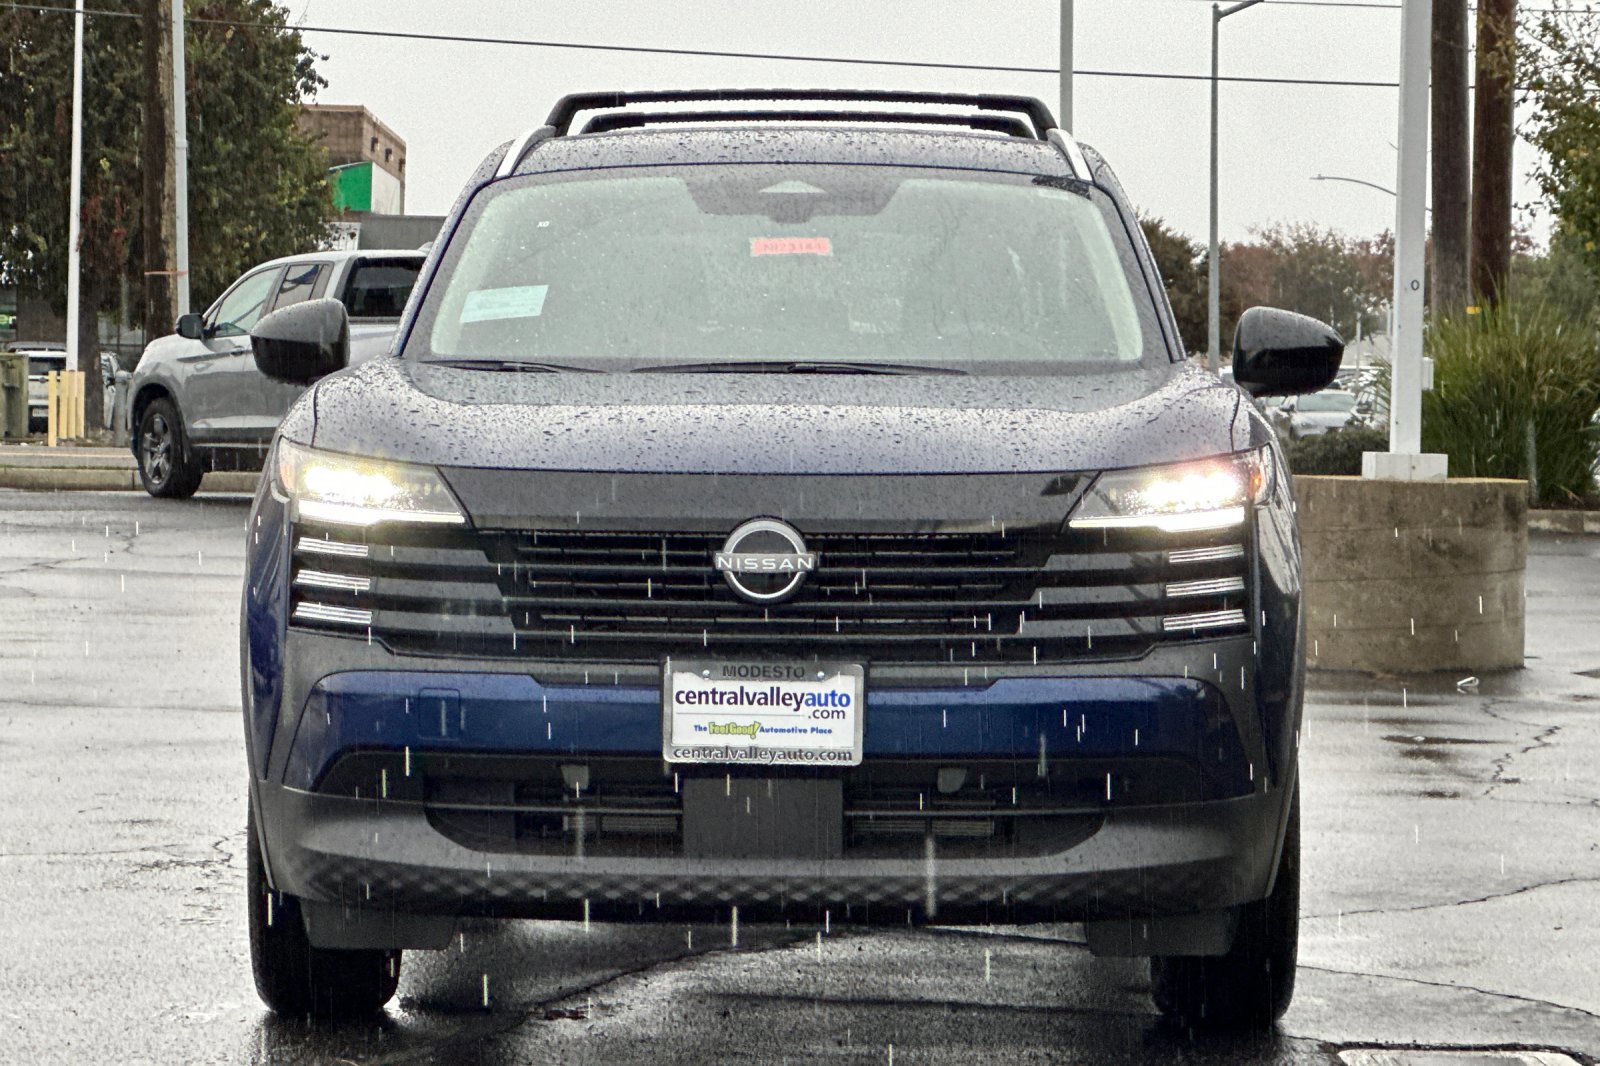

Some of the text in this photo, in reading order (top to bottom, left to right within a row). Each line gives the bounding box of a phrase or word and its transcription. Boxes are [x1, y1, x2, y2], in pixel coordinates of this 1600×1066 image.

[717, 556, 813, 570] NISSAN
[722, 665, 805, 679] MODESTO
[675, 686, 851, 712] centralvalleyauto
[808, 708, 846, 720] .com
[694, 724, 708, 732] The
[759, 726, 808, 734] Automotive
[810, 727, 833, 735] Place
[673, 746, 853, 764] centralvalleyauto.com
